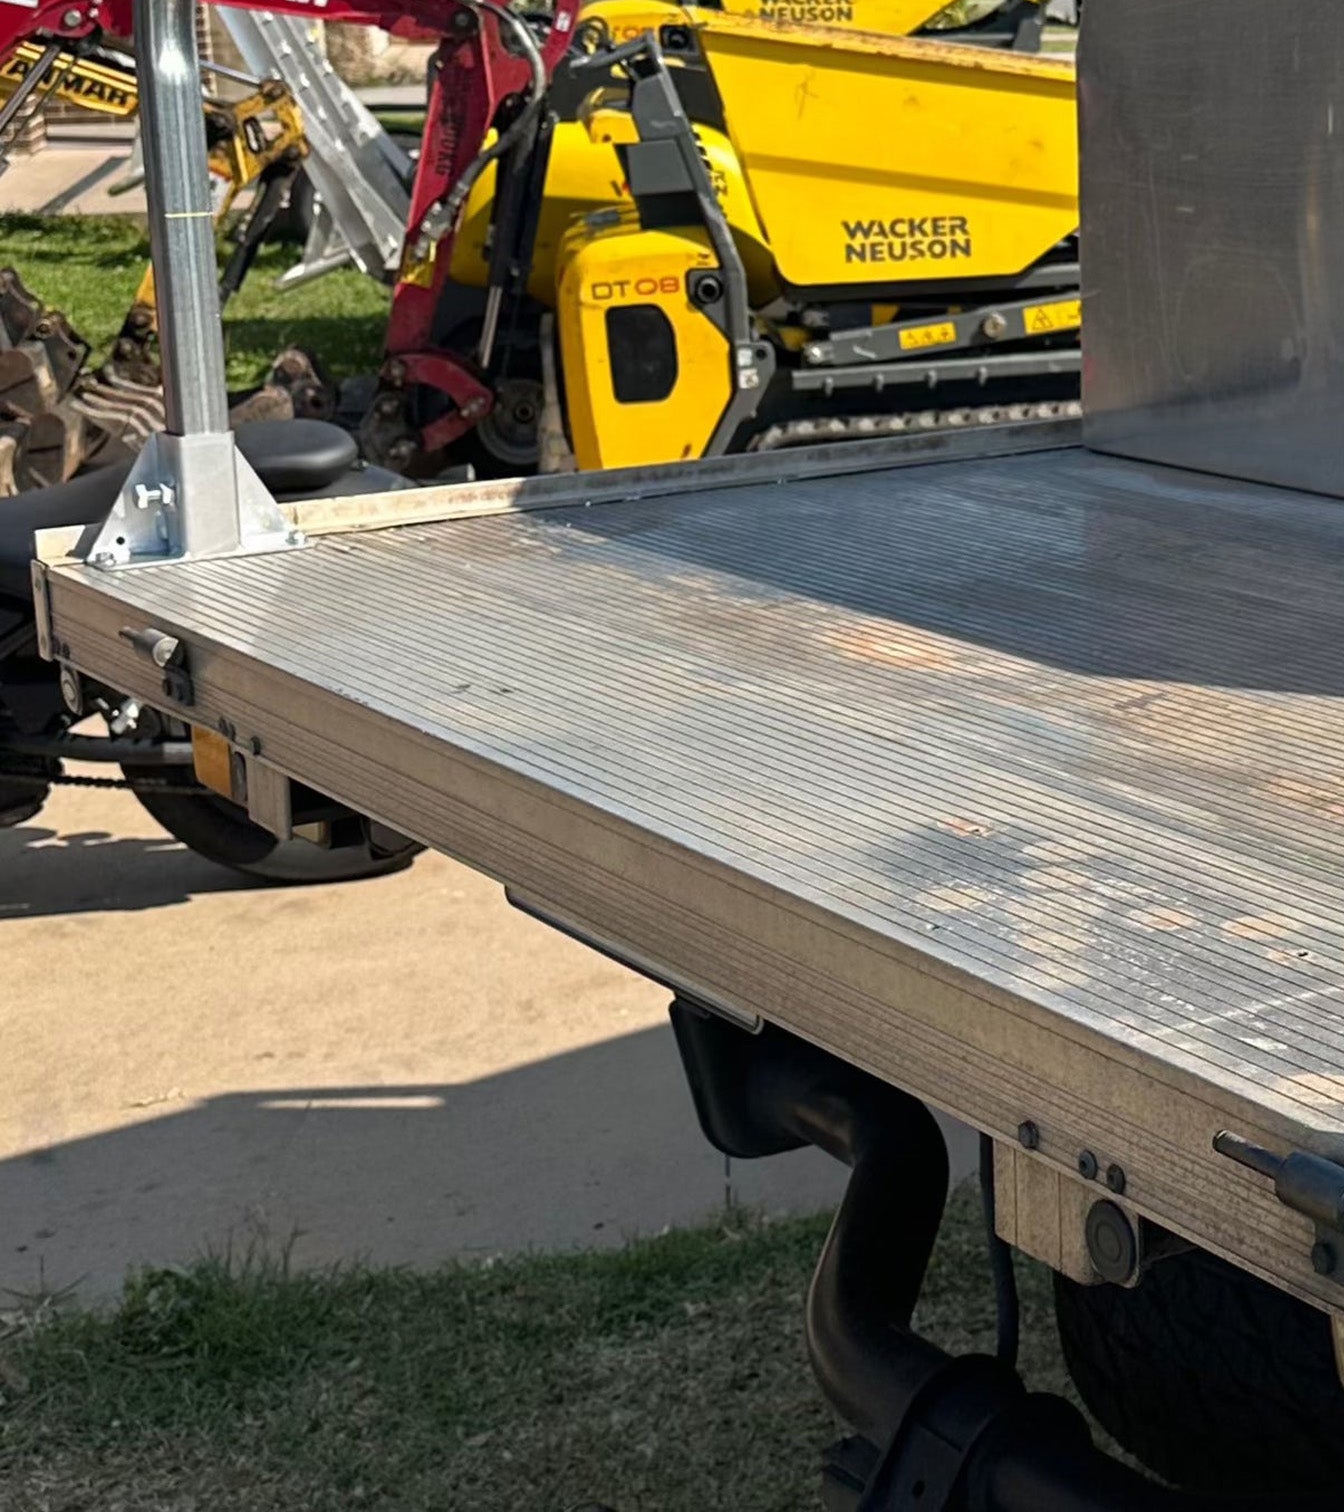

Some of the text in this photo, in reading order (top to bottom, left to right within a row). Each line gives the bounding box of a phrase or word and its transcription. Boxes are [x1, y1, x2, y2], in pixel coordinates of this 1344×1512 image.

[759, 7, 853, 24] NEUSON
[841, 216, 970, 240] WACKER
[845, 238, 972, 263] NEUSON
